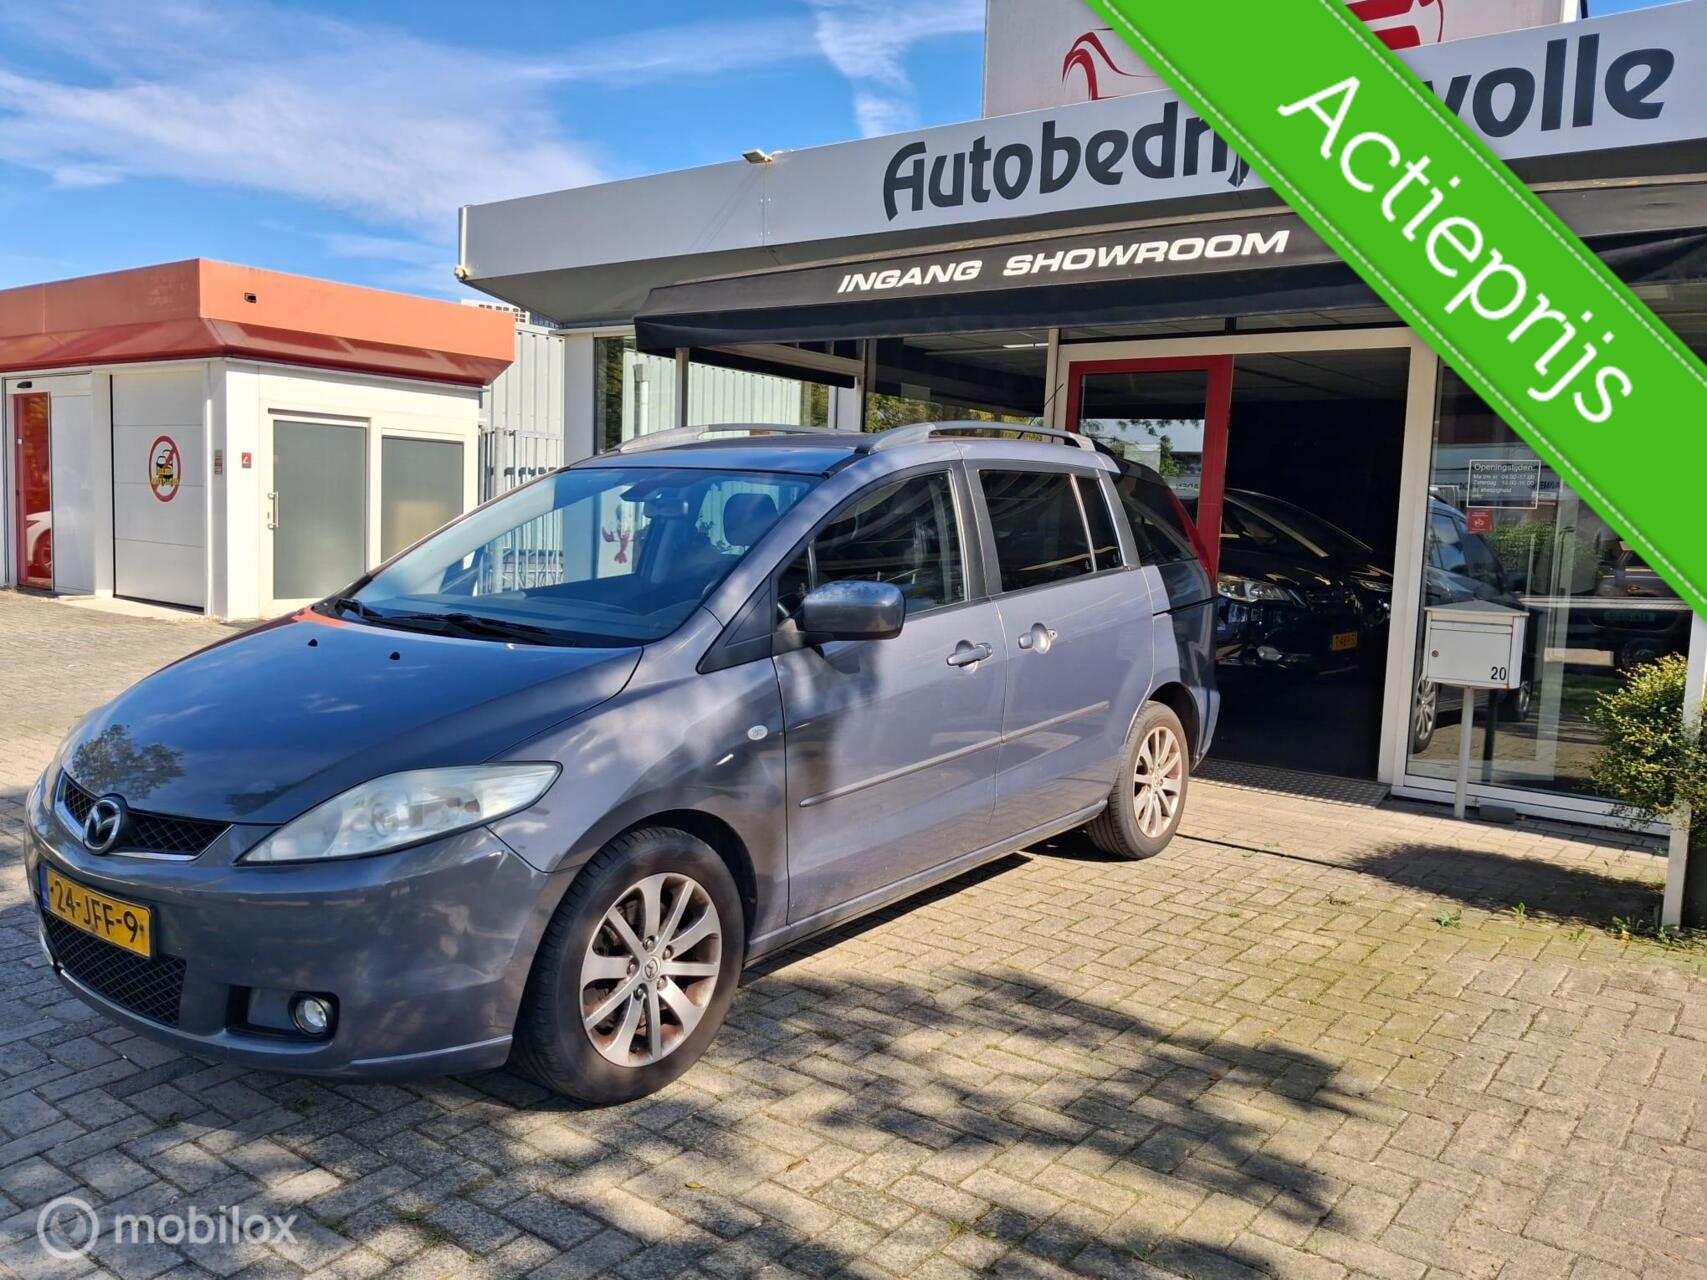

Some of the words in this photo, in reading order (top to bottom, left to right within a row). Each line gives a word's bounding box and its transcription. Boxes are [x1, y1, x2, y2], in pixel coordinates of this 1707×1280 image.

[838, 260, 982, 293] INGANG
[1003, 230, 1290, 277] SHOWROOM
[1490, 666, 1507, 681] 20
[55, 879, 139, 943] 24-JFF-9
